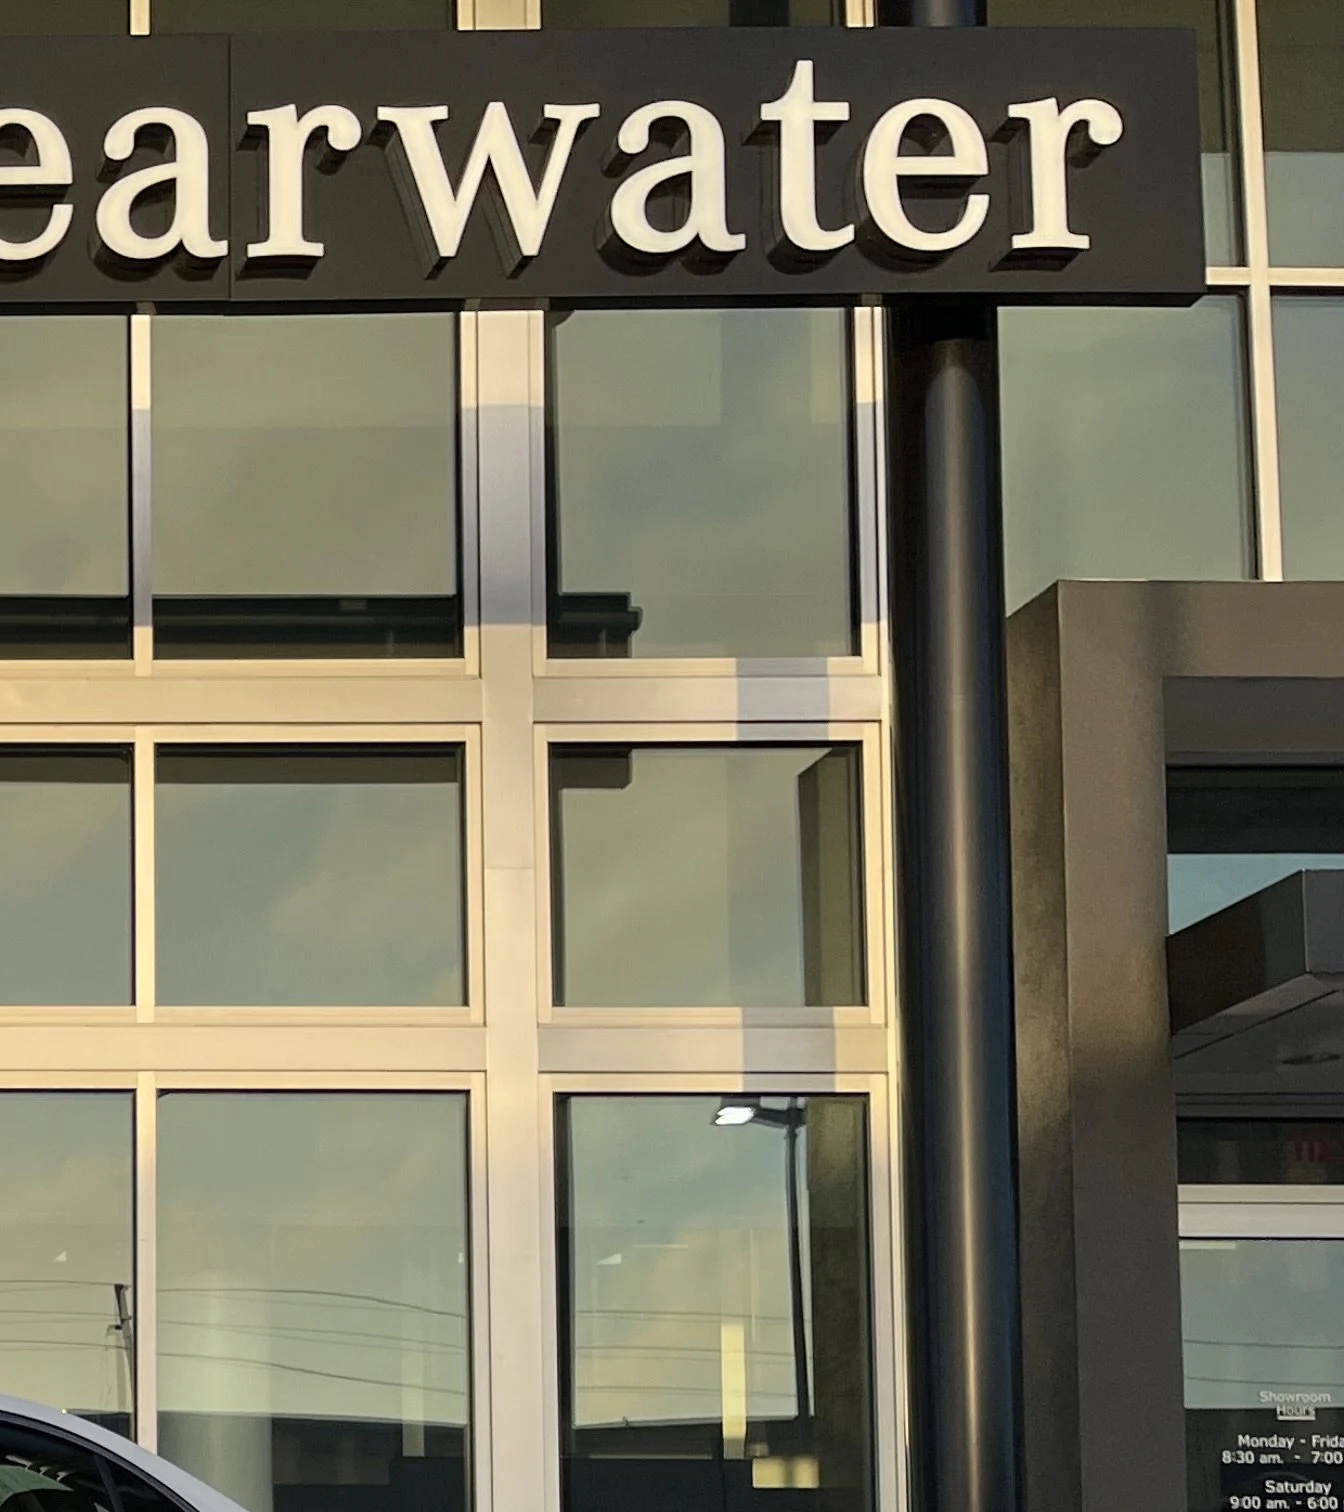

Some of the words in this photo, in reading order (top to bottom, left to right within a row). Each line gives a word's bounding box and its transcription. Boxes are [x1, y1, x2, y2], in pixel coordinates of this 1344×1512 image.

[1259, 1390, 1332, 1402] Showroom
[1276, 1404, 1316, 1417] Hours
[1237, 1434, 1295, 1450] Monday
[1222, 1450, 1255, 1464] 8:30
[1311, 1450, 1344, 1464] 7:00
[1265, 1480, 1332, 1495] Saturday
[1229, 1496, 1262, 1509] 9:00
[1307, 1496, 1338, 1510] 6:00
